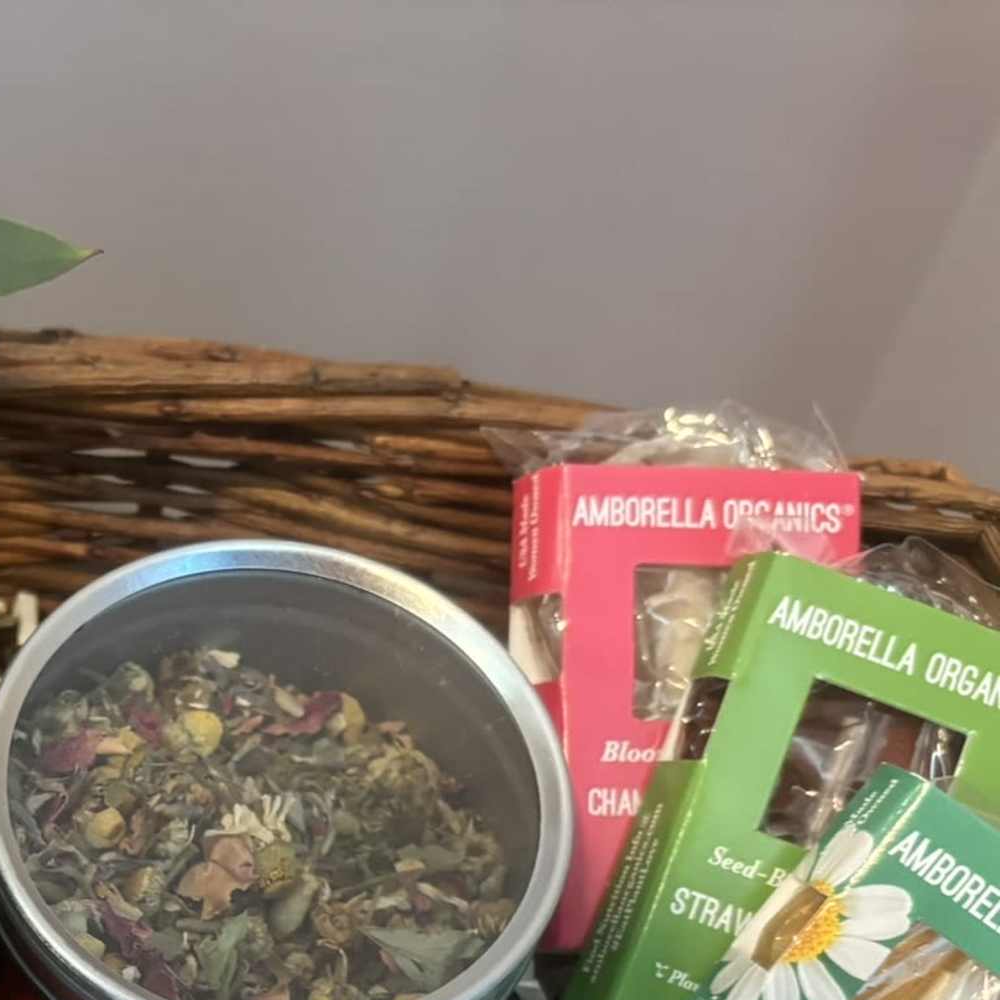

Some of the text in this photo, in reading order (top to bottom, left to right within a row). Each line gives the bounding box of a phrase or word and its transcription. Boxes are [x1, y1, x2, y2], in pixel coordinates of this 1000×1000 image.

[572, 495, 717, 530] AMBORELLA
[767, 595, 917, 676] AMBORELLA
[887, 830, 1000, 934] AMBOREL
